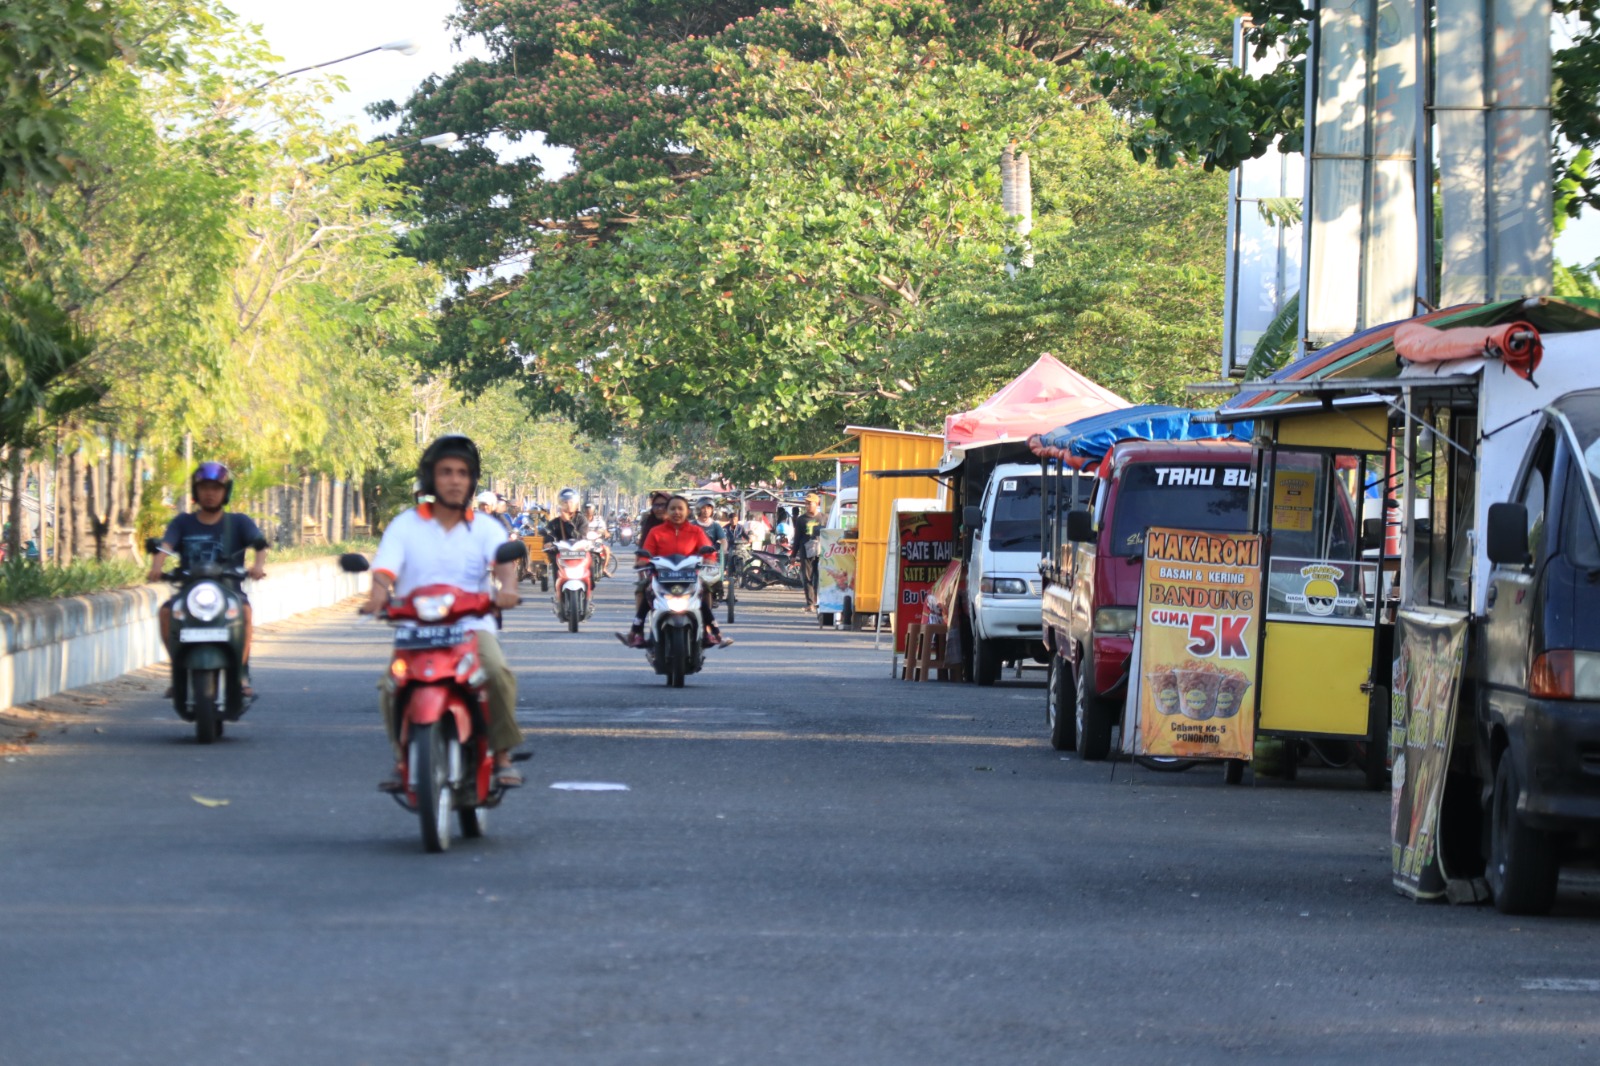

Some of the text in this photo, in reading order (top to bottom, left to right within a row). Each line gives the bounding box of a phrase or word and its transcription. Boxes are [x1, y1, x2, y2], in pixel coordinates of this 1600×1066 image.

[1155, 468, 1215, 486] TAHU
[1223, 469, 1258, 488] BU
[1147, 532, 1260, 567] MAKARONI
[904, 567, 925, 581] SATE
[1159, 567, 1244, 584] BASAH & KERING
[903, 589, 918, 604] Bu
[1149, 584, 1254, 610] BANDUNG
[1151, 611, 1189, 626] CUMA
[1187, 615, 1251, 659] 5K
[1171, 722, 1226, 734] Cabang Ke-5
